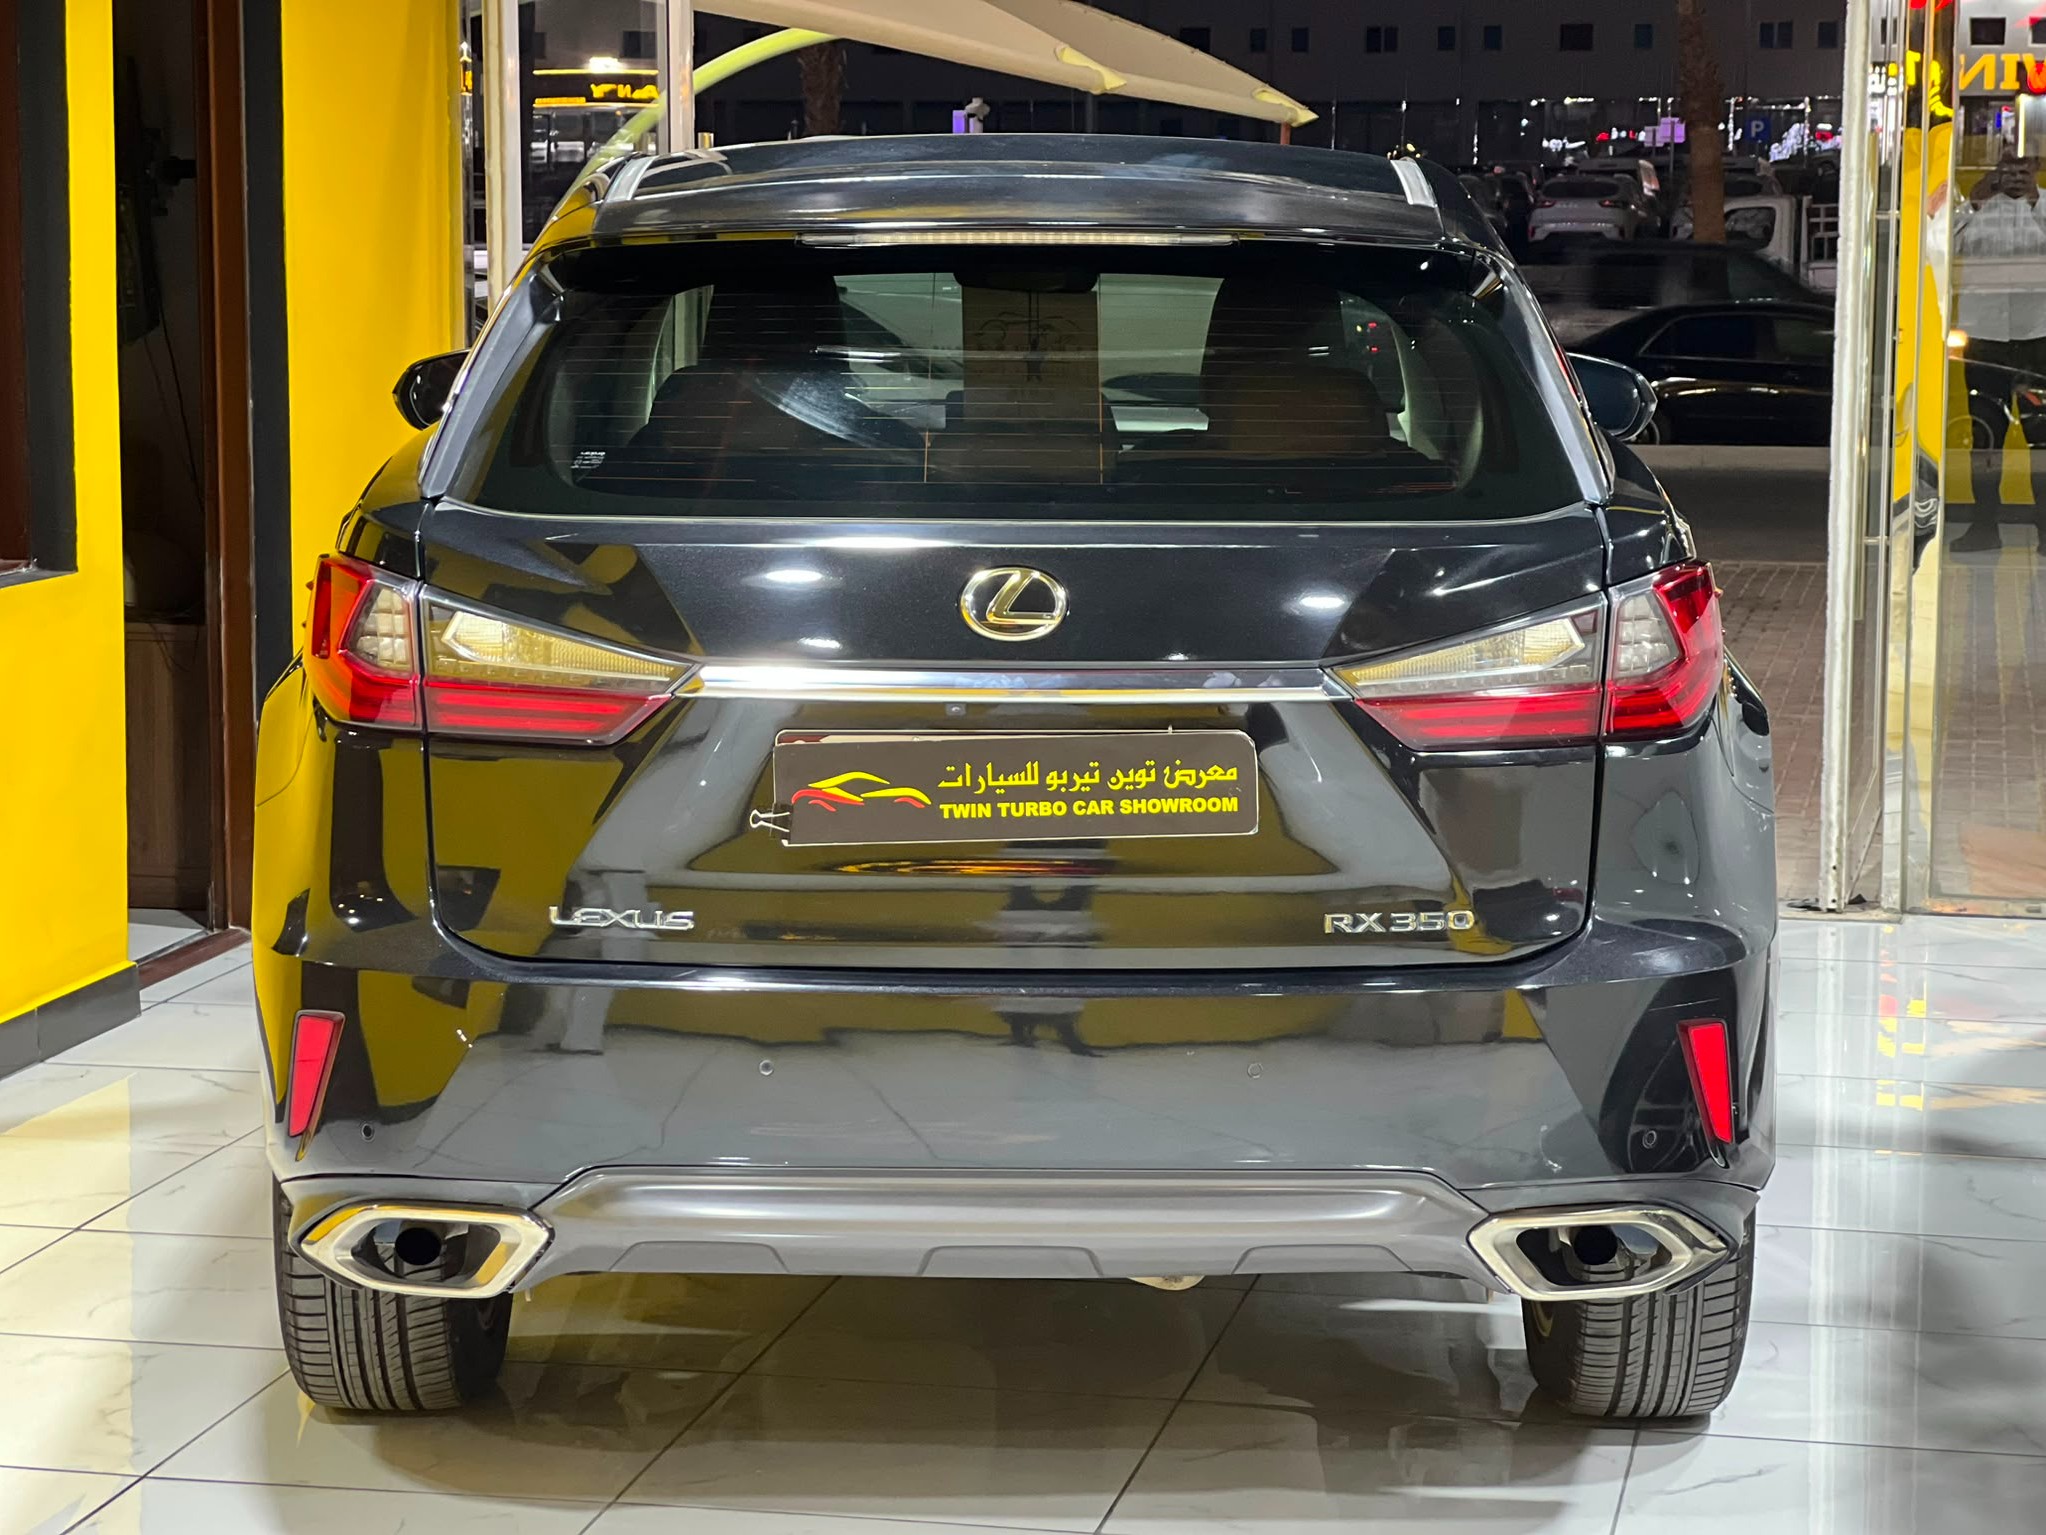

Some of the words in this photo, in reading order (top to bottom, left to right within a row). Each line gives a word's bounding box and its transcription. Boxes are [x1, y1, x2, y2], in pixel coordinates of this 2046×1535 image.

[1750, 119, 1765, 138] P
[937, 760, 1039, 795] للسيارات
[1045, 760, 1100, 792] تيربو
[1106, 759, 1157, 791] توين
[1163, 758, 1238, 789] معرض
[939, 802, 992, 819] TWIN
[997, 800, 1067, 817] TURBO
[1073, 799, 1114, 816] CAR
[1119, 796, 1238, 815] SHOWROOM
[549, 905, 695, 931] LEXUS
